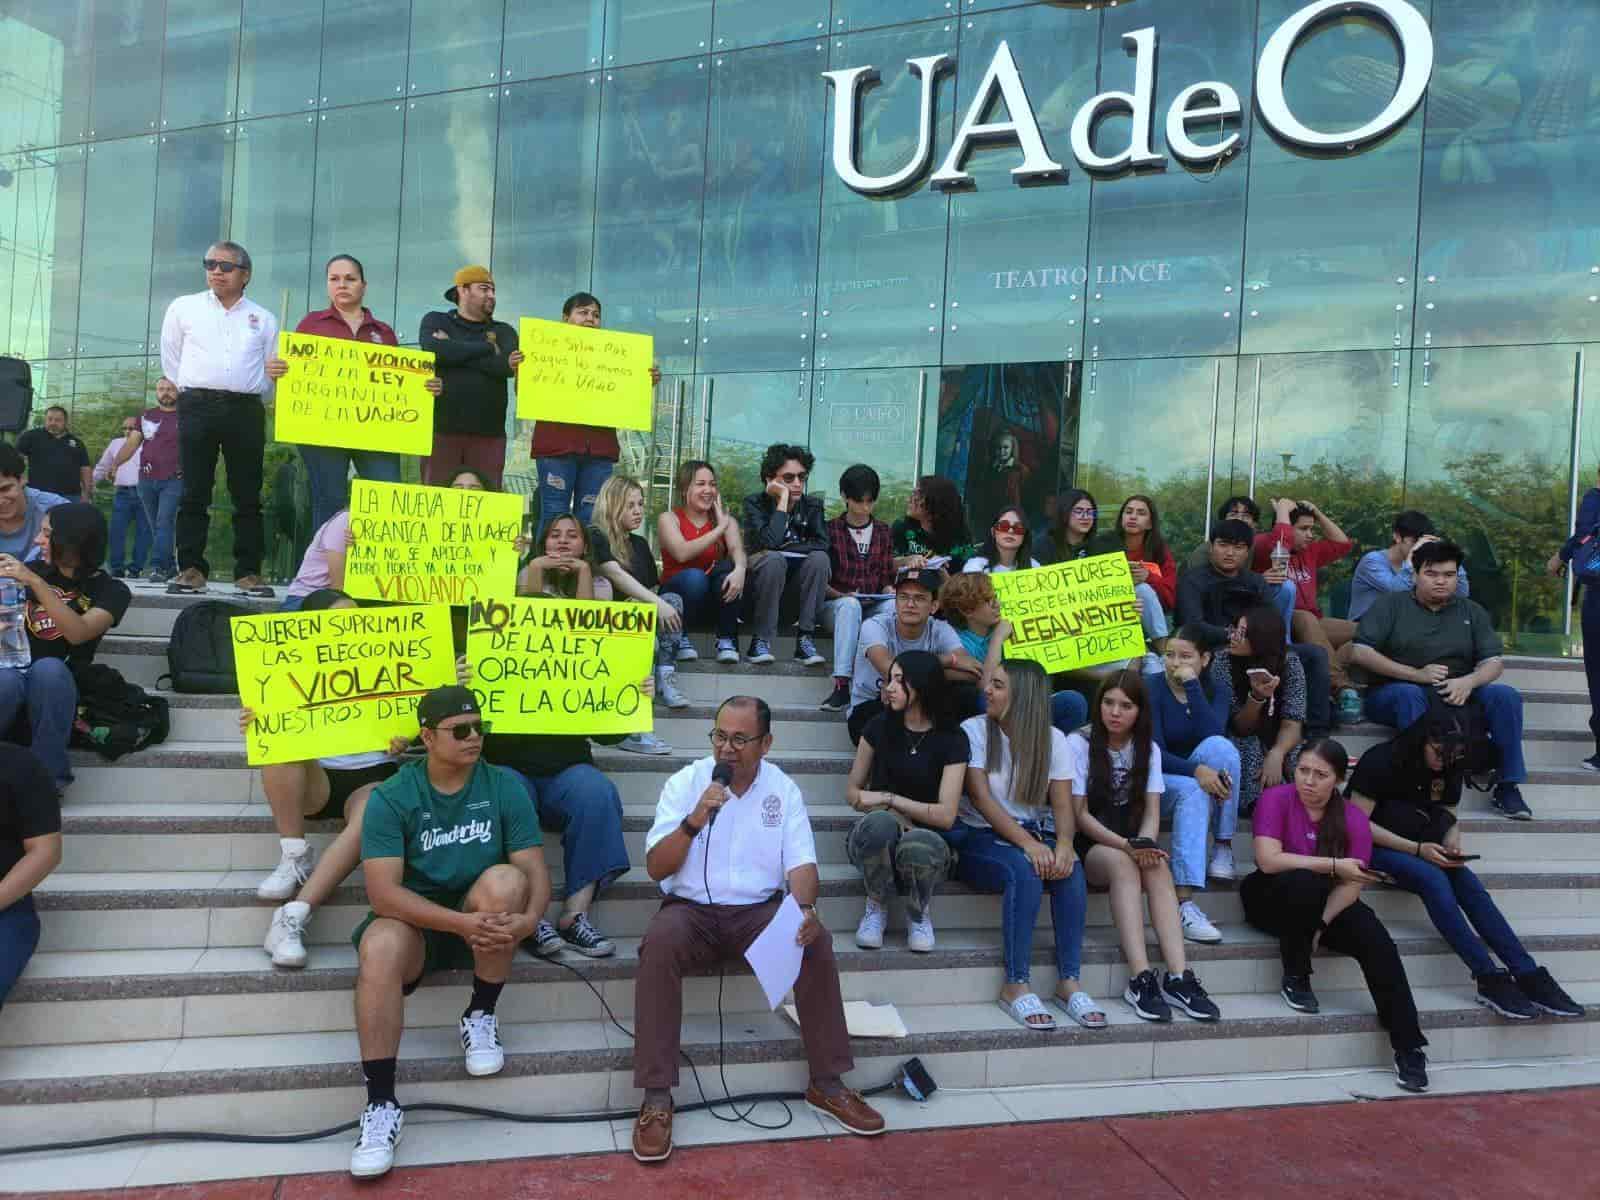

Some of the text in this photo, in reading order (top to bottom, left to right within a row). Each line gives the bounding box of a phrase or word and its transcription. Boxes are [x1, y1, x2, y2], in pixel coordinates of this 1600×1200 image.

[822, 0, 1434, 193] UAdeO
[992, 263, 1172, 289] TEATRO LINCE
[369, 371, 405, 387] LEY
[291, 381, 407, 406] ORGANICA
[292, 399, 313, 416] DE
[356, 406, 419, 423] UAdeO
[359, 488, 484, 519] LA NUEVA LEY
[350, 518, 428, 544] ORGANICA
[441, 522, 457, 544] DE
[462, 521, 475, 543] LA
[384, 546, 400, 561] NO
[408, 546, 420, 561] SE
[490, 546, 497, 562] Y
[424, 561, 435, 574] YA
[445, 562, 457, 575] LA
[1002, 557, 1128, 595] PEDRO FLORES
[234, 611, 427, 646] QUIEREN SUPRIMIR
[520, 605, 537, 627] A
[542, 608, 564, 631] LA
[262, 635, 433, 667] LAS ELECCIONES
[491, 632, 605, 657] DE LA LEY
[1044, 643, 1068, 663] EL
[1074, 628, 1140, 662] PODER
[255, 662, 425, 704] Y VIOLAR
[519, 689, 554, 714] LA
[562, 683, 640, 716] UAdeO
[254, 697, 420, 736] NUESTROS DER
[257, 738, 270, 758] S
